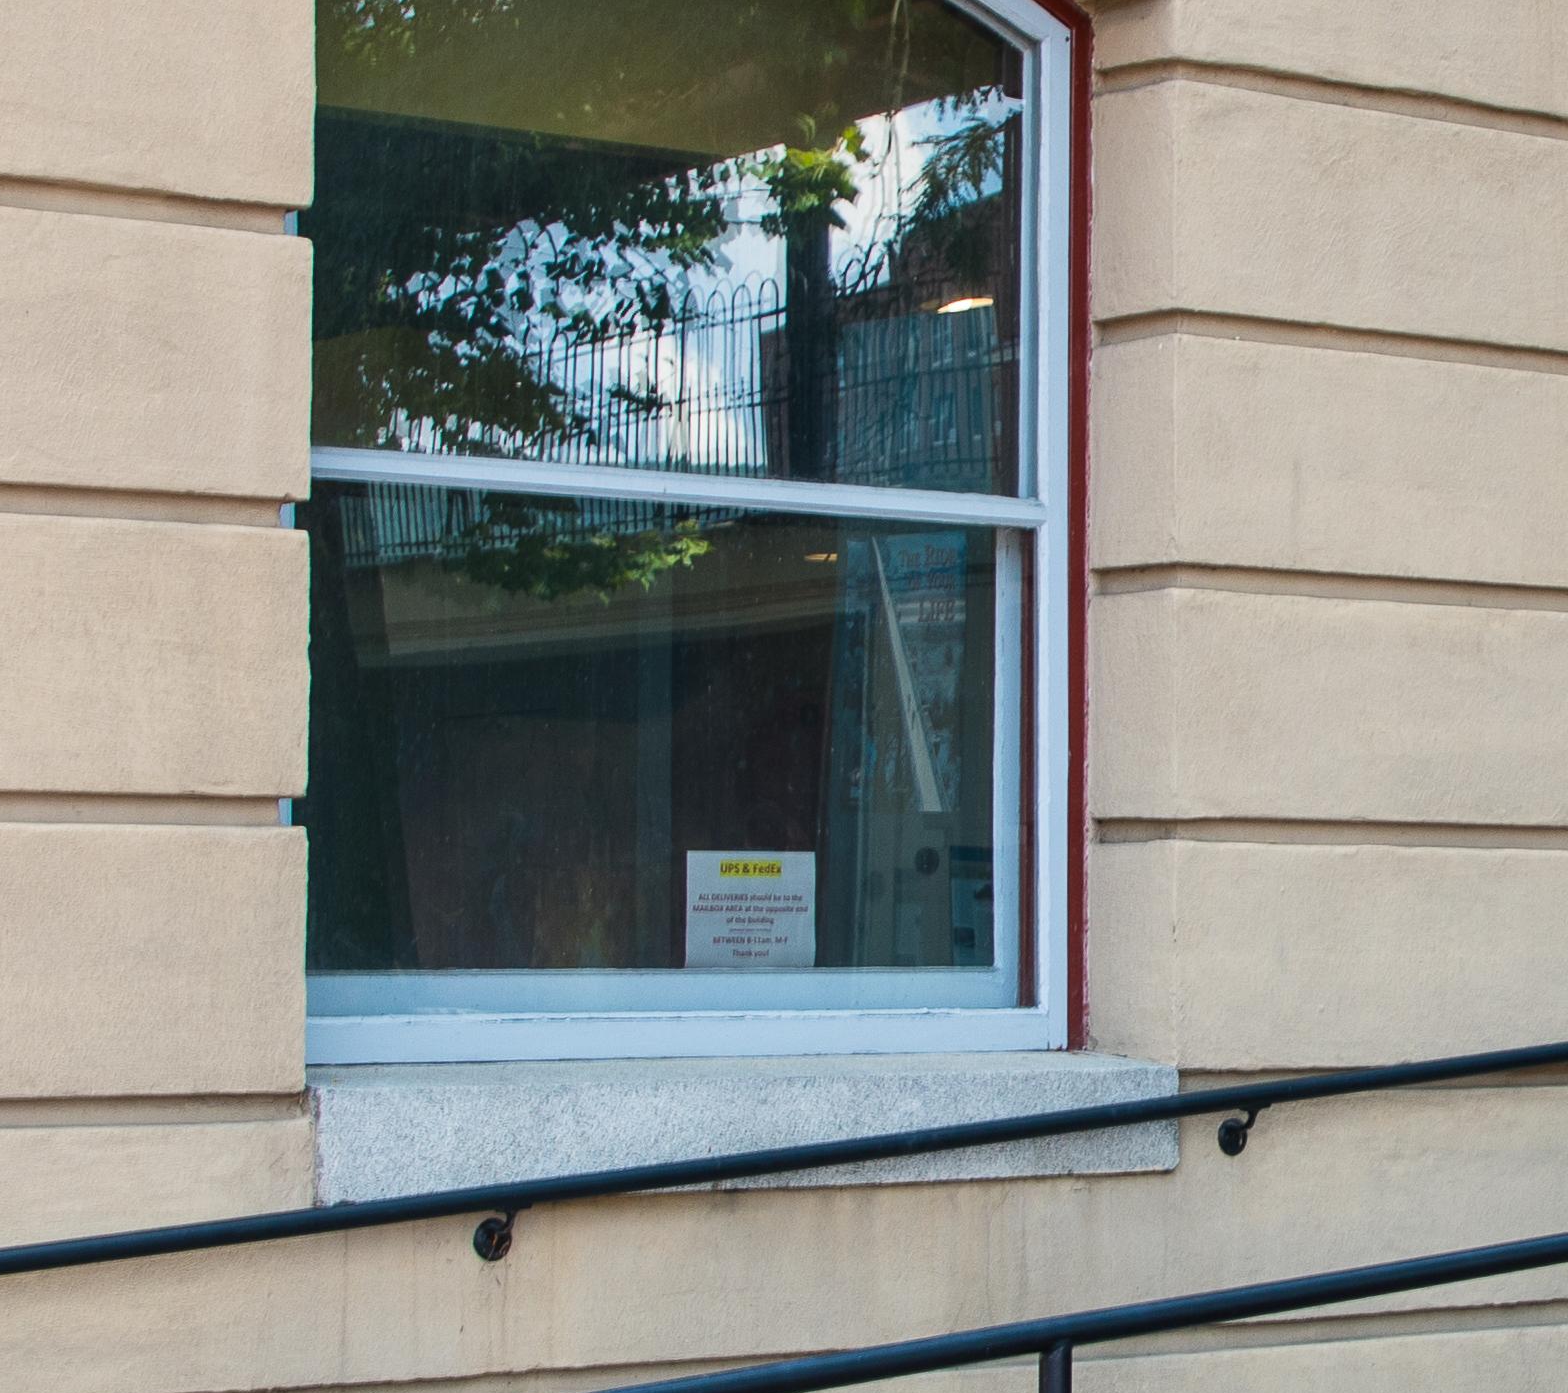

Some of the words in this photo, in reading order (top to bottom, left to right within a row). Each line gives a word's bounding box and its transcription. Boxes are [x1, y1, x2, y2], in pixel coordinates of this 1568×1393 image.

[918, 599, 955, 622] LIFE
[720, 863, 740, 874] UPS
[742, 863, 750, 874] &
[752, 863, 782, 874] FedEx
[698, 894, 710, 902] ALL
[711, 894, 748, 902] DELIVERIES
[713, 936, 745, 944] BETWEEN
